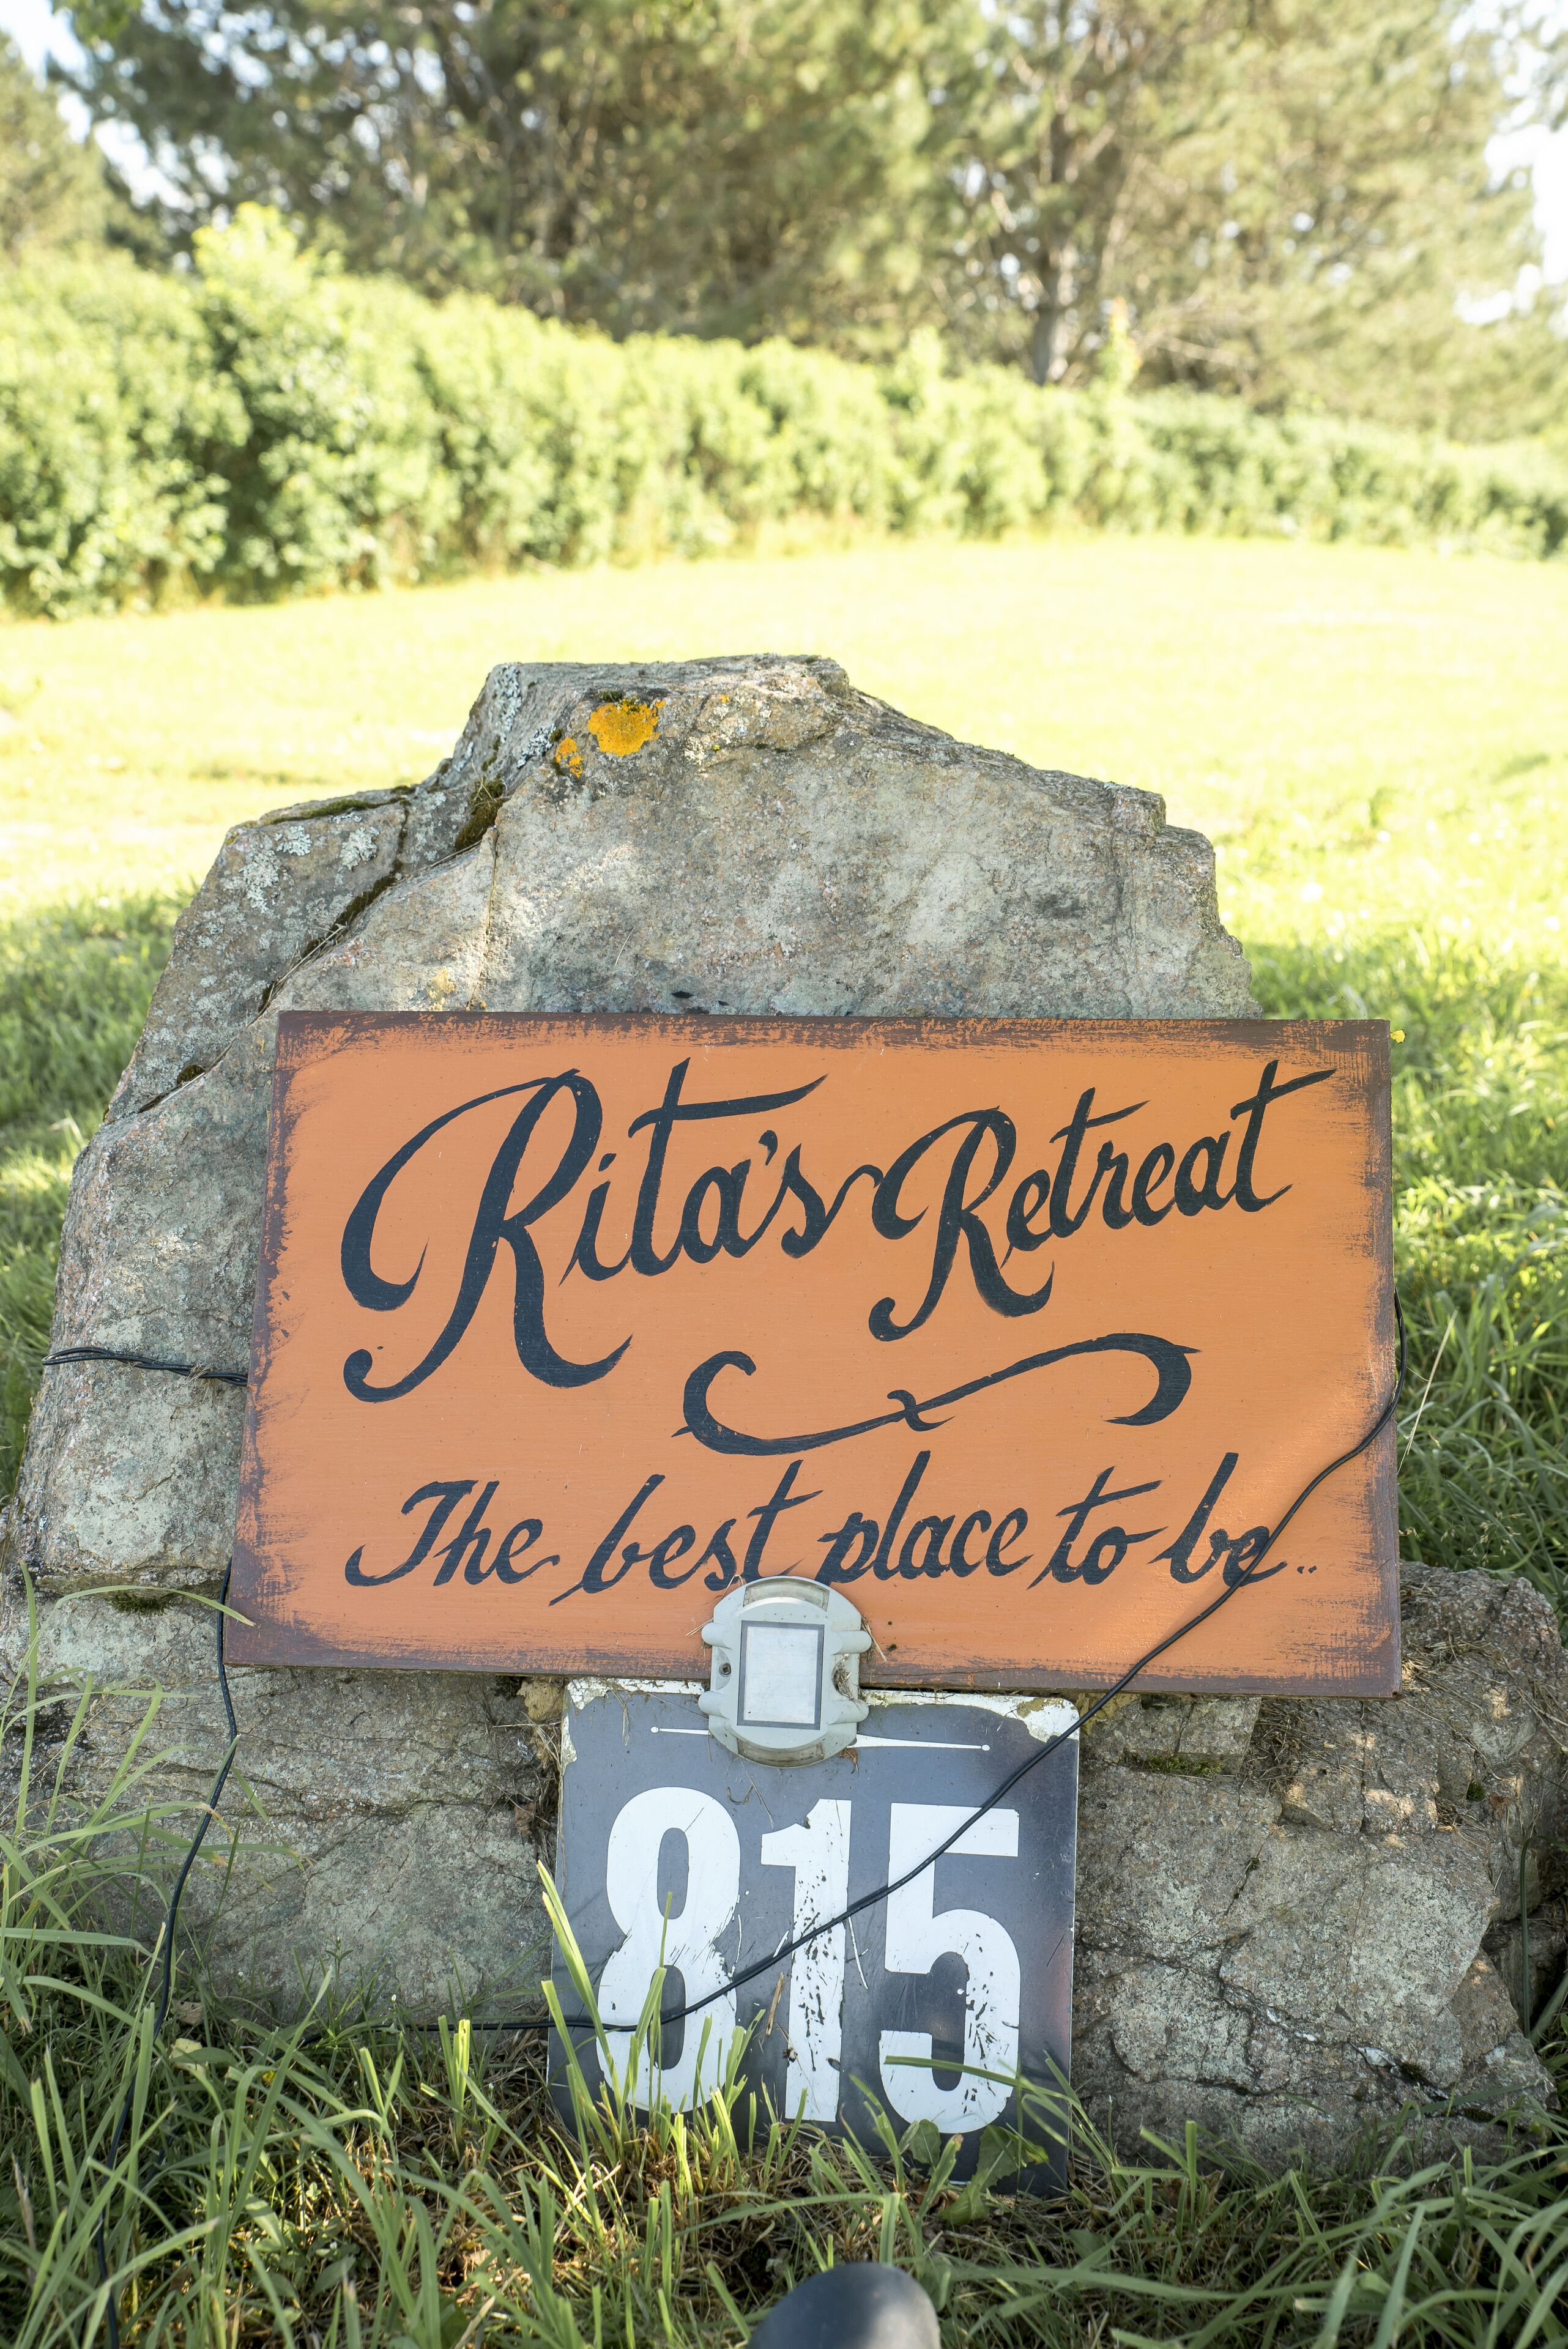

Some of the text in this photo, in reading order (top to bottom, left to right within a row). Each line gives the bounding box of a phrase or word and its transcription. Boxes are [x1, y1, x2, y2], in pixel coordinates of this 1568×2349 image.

[341, 1057, 1337, 1403] Rita's Retreat
[344, 1479, 560, 1586] The
[549, 1460, 822, 1606] best
[817, 1450, 1034, 1586] place
[1027, 1466, 1167, 1589] to
[596, 1786, 1021, 2134] 815
